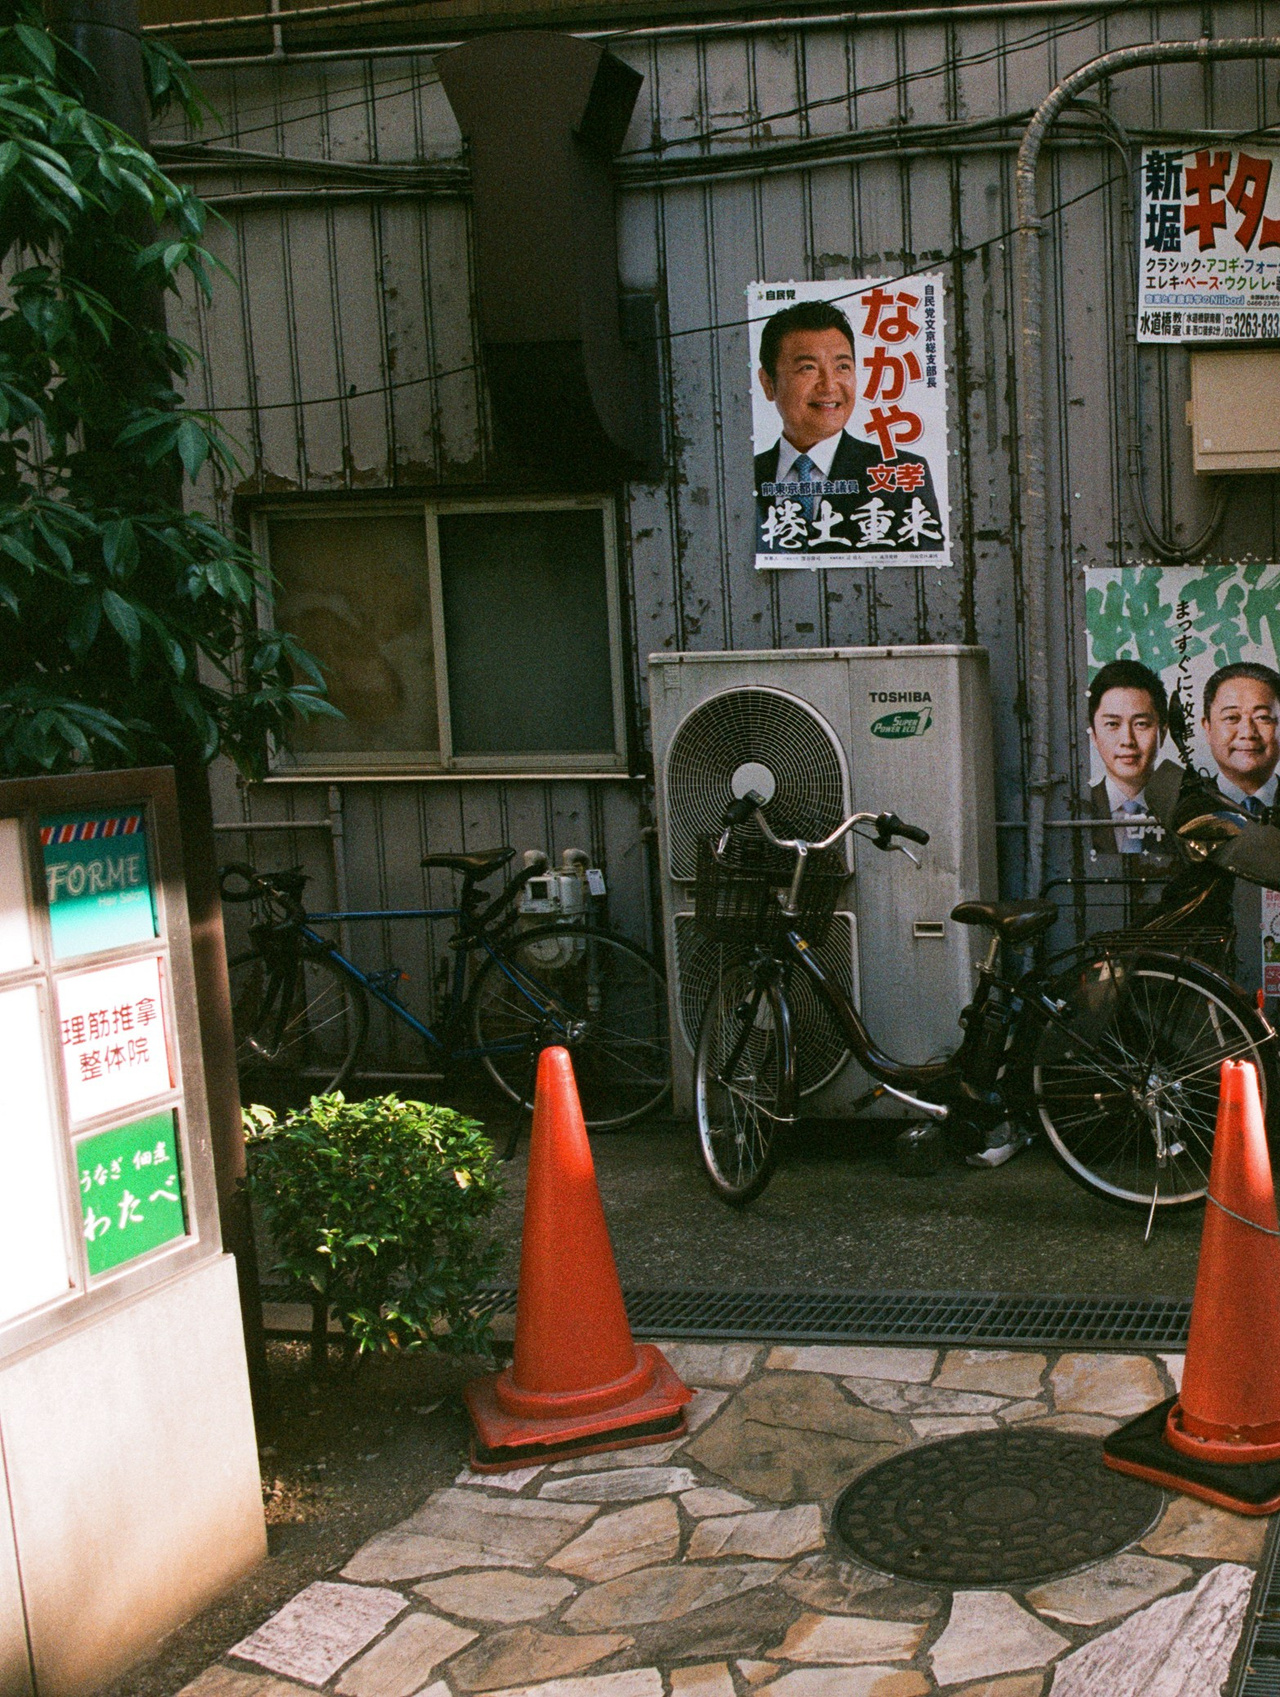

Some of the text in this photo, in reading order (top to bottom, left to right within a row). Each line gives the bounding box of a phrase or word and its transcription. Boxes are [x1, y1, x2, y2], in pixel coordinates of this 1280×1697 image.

[1145, 150, 1181, 252] 新堀
[766, 289, 796, 301] 自民党
[860, 287, 926, 462] なかや
[867, 463, 926, 493] 文孝
[869, 691, 932, 703] TOSHIBA
[47, 854, 142, 903] FORME
[60, 997, 157, 1046] 理筋推拿
[79, 1040, 151, 1082] 整体院
[80, 1156, 123, 1193] うなぎ
[83, 1174, 179, 1243] わたべ
